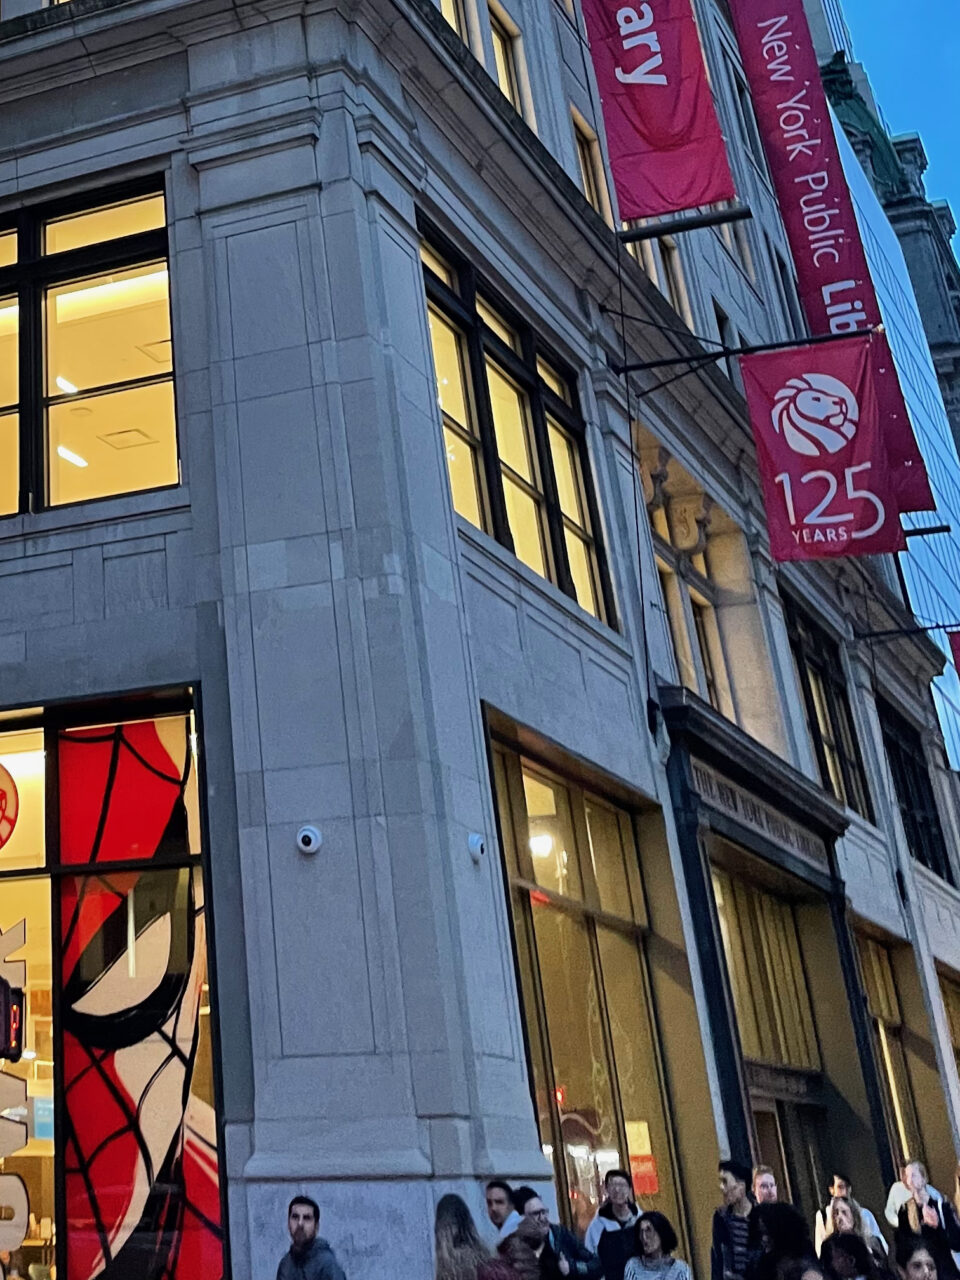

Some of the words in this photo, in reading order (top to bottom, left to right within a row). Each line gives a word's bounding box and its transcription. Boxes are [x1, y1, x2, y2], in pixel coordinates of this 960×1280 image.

[757, 14, 795, 82] New
[776, 87, 822, 162] York
[794, 170, 845, 268] Public
[775, 461, 886, 539] 125
[792, 526, 849, 545] YEARS
